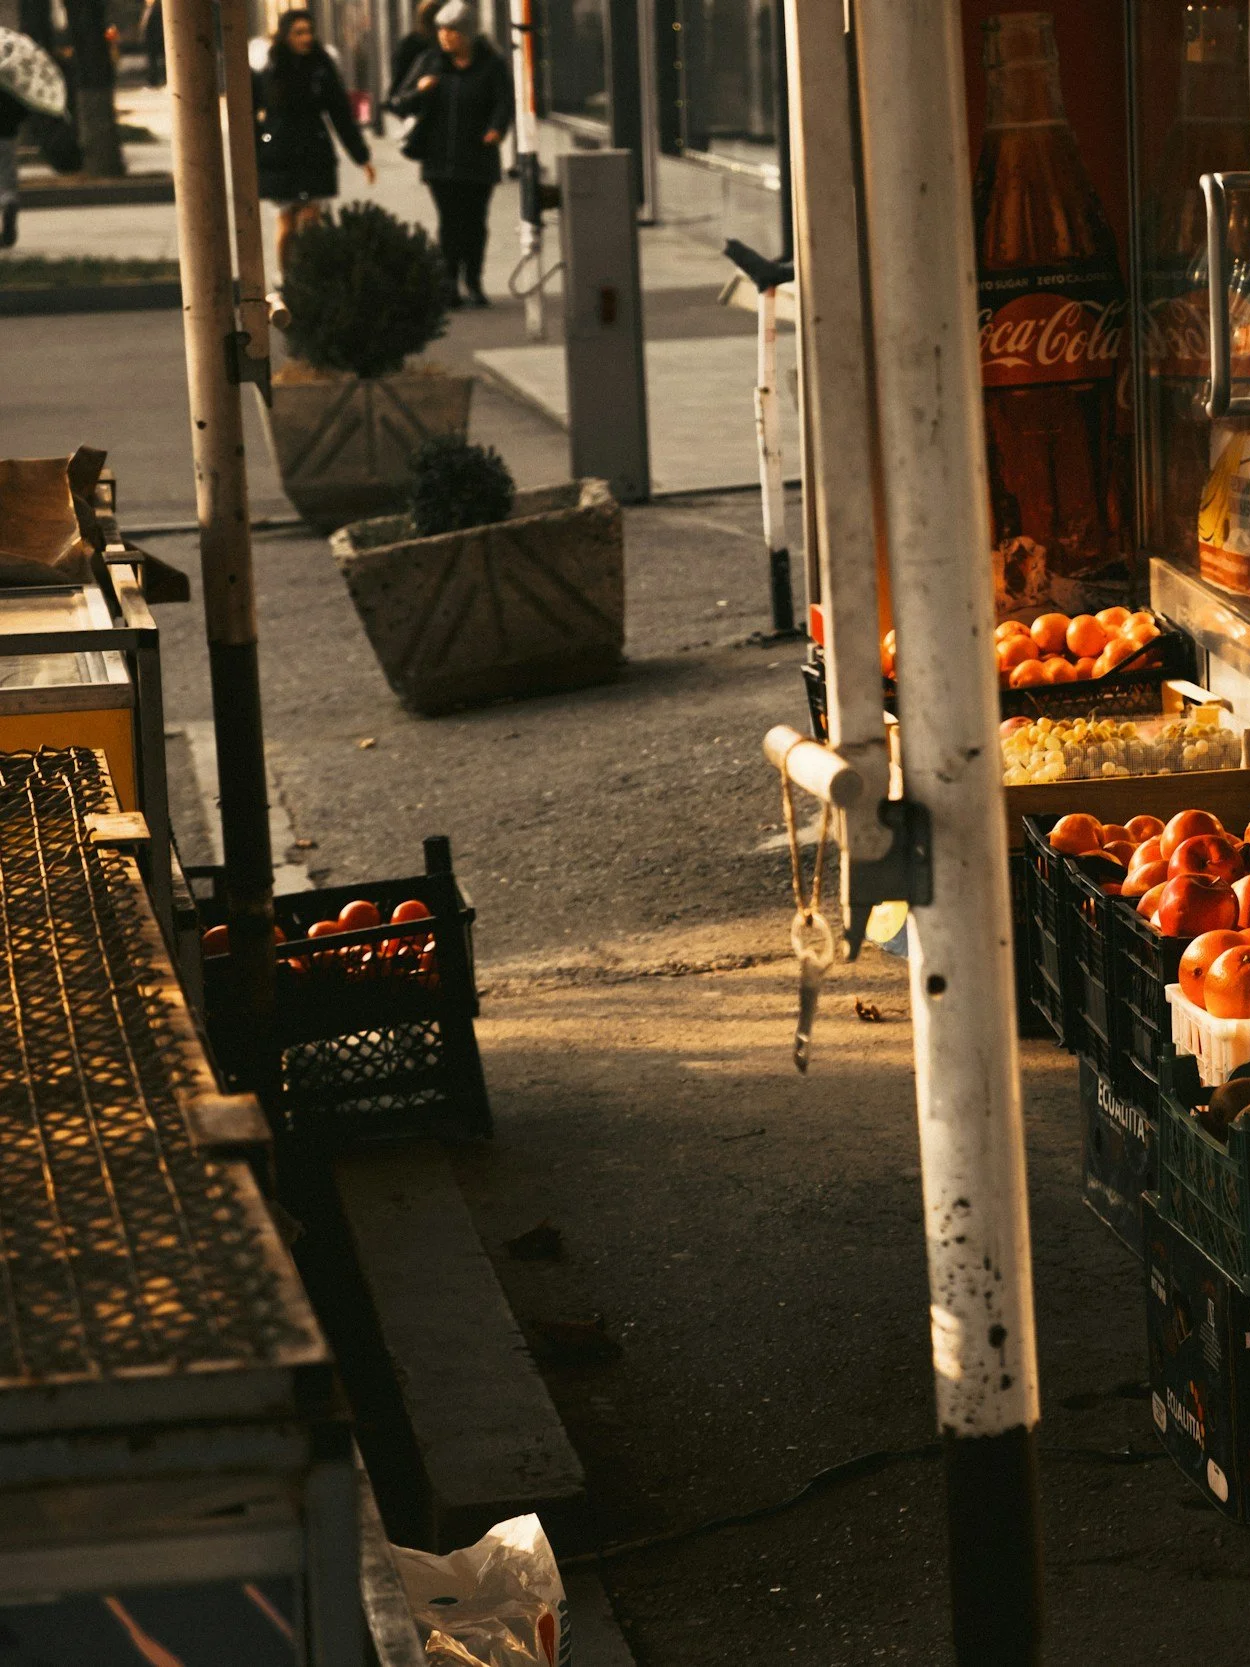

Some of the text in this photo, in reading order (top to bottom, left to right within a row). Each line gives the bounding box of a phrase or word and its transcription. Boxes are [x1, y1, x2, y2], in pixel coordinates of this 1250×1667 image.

[995, 278, 1029, 290] SUGAR
[1036, 274, 1065, 286] zero
[1097, 1075, 1147, 1144] ECUALITTA
[1165, 1385, 1203, 1448] ECUALITTA
